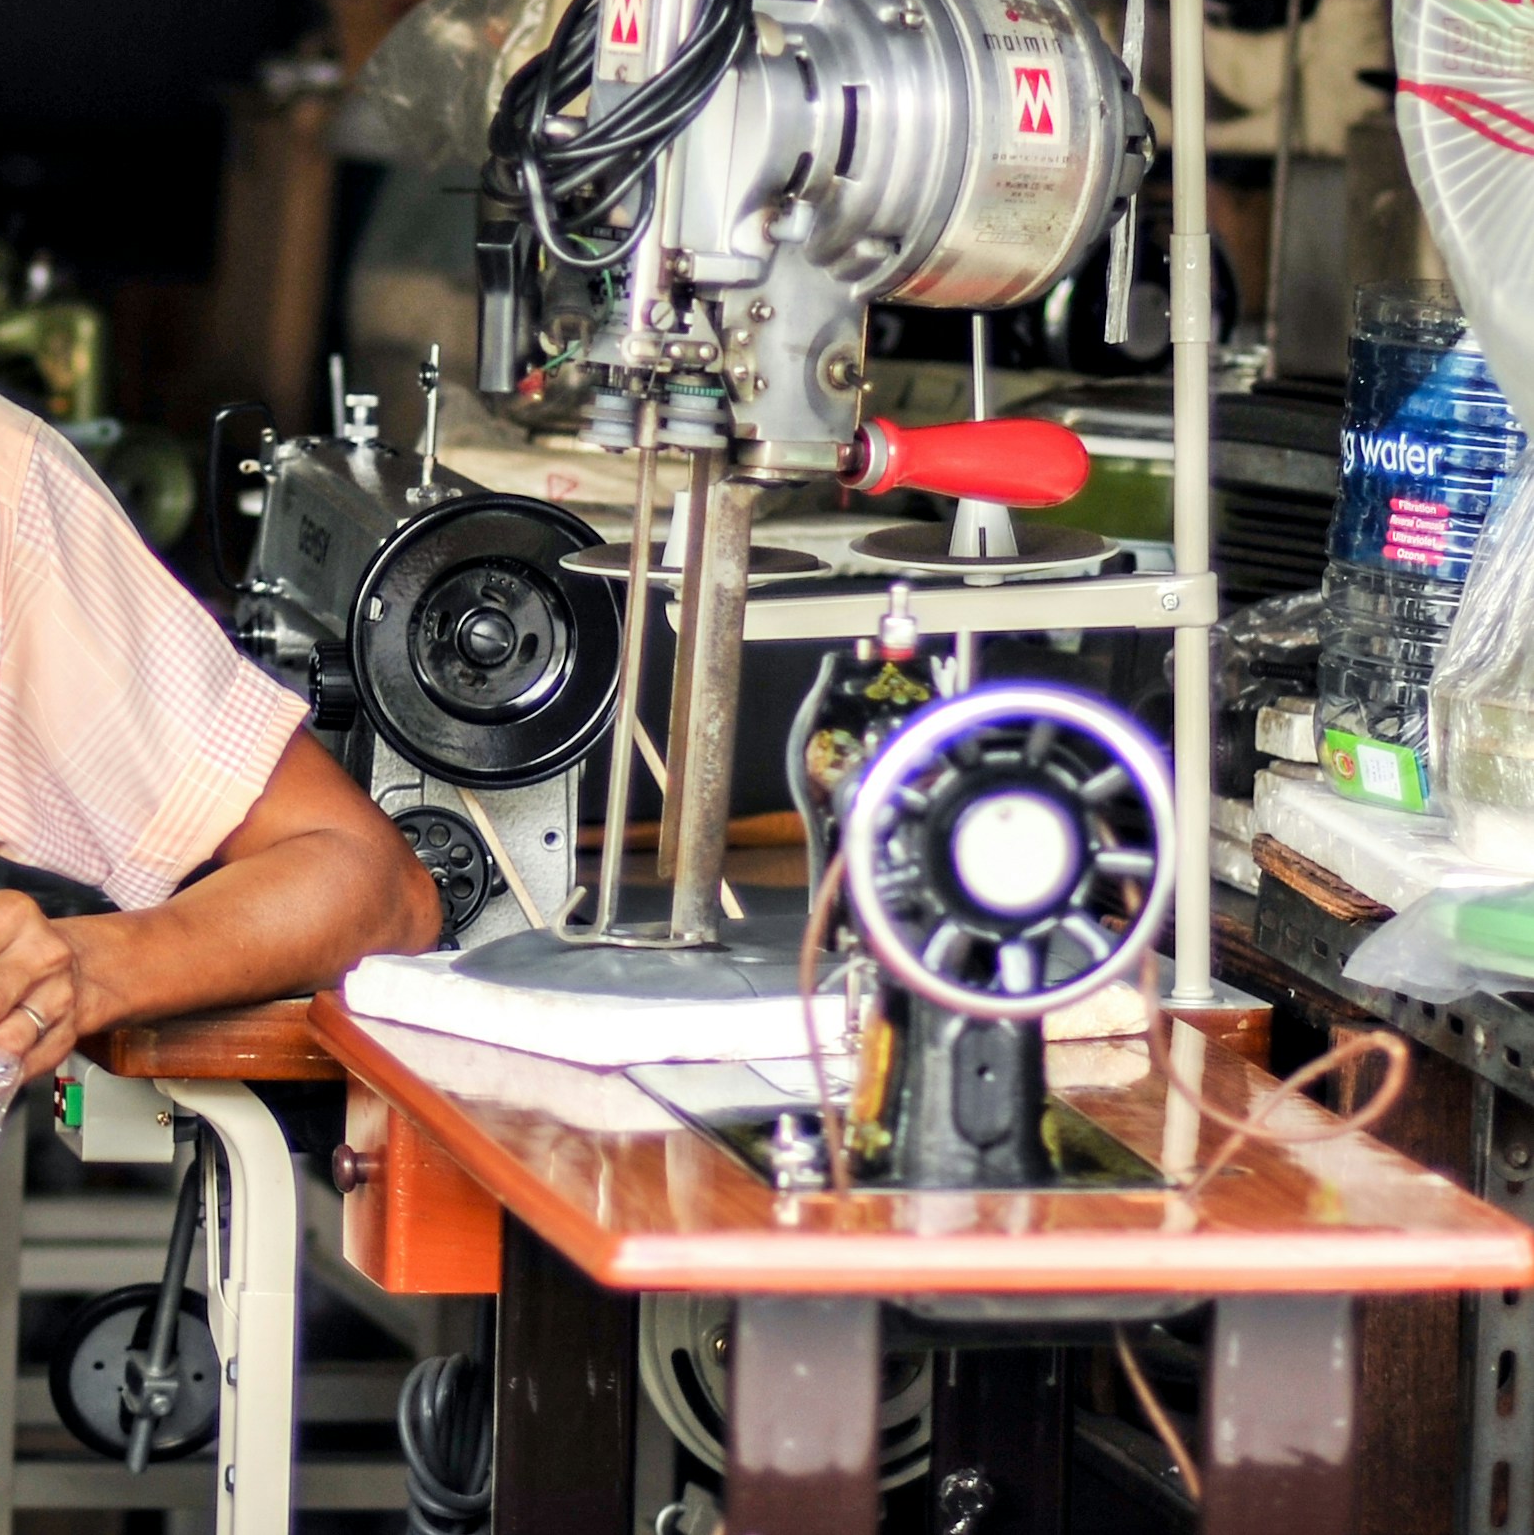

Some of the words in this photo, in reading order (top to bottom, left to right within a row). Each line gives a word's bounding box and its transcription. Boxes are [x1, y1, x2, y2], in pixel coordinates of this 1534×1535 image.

[1360, 431, 1444, 477] water
[1398, 499, 1437, 515] Filtration
[1392, 531, 1436, 547] Ultraviolet
[1396, 548, 1426, 563] Ozone
